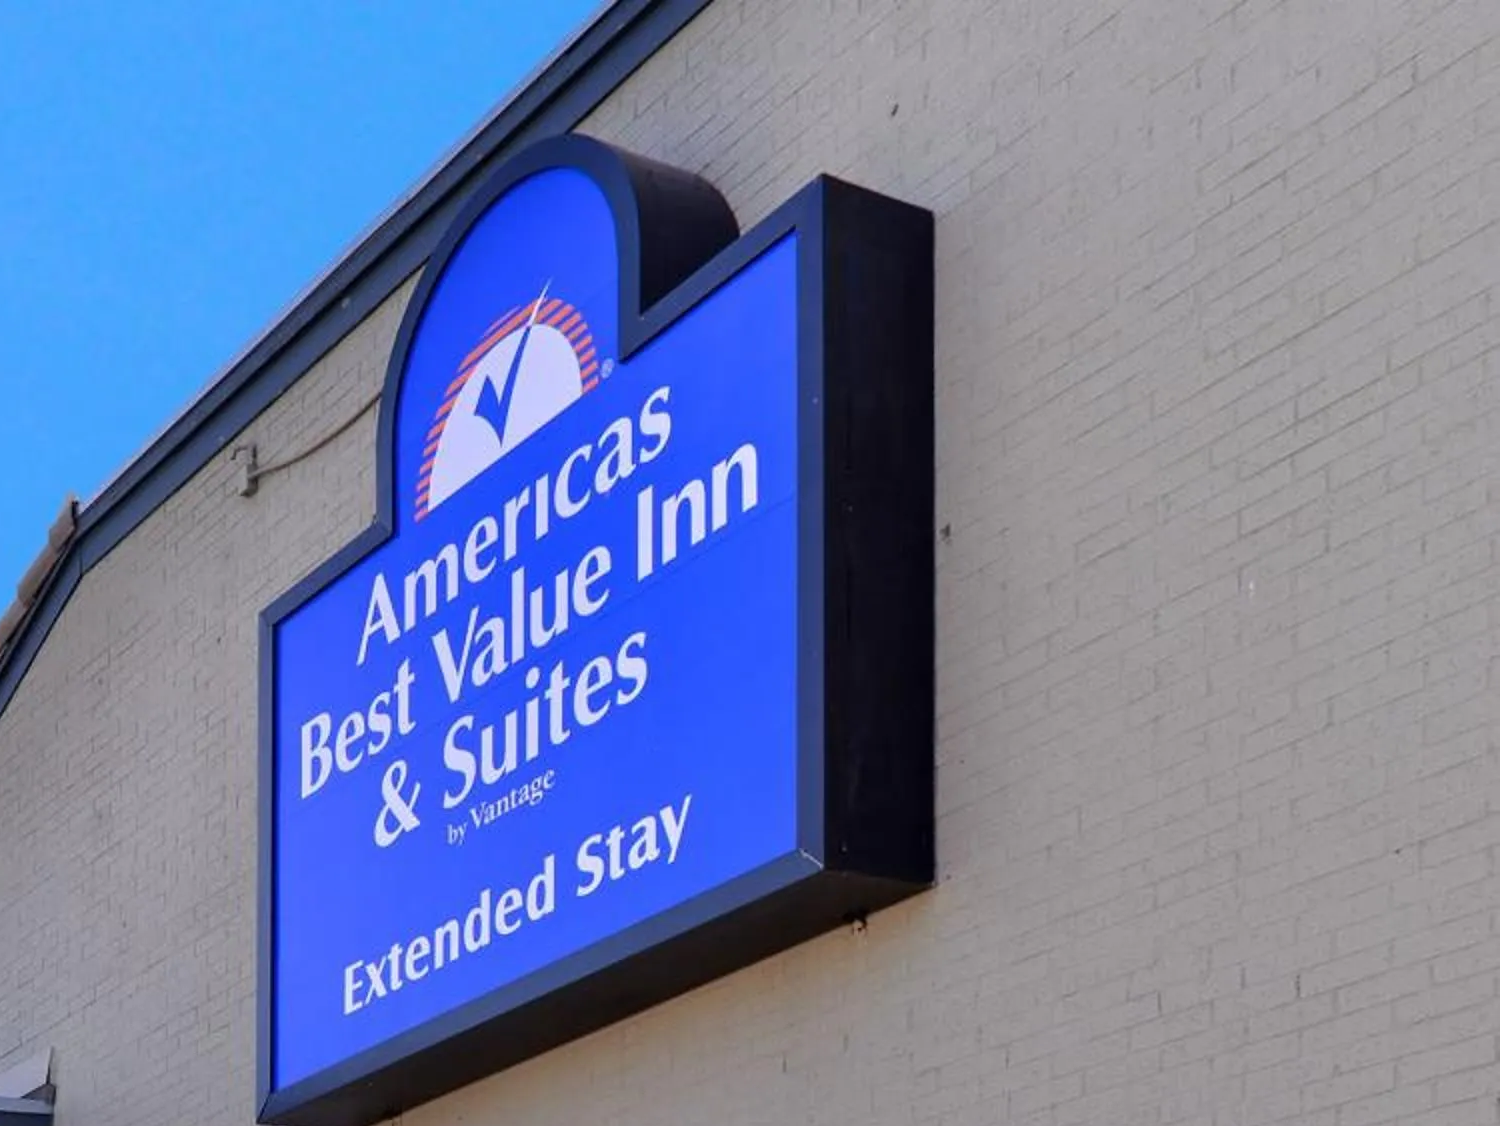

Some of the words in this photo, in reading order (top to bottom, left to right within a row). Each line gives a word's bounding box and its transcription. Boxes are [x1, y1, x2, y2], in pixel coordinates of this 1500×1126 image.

[301, 659, 416, 799] Best
[432, 546, 612, 706] Value
[637, 443, 758, 581] Inn
[357, 386, 671, 665] Americas
[374, 760, 421, 847] &
[443, 632, 647, 809] Suites
[447, 821, 468, 846] by
[470, 769, 556, 829] Vantage
[344, 854, 555, 1015] Extended
[576, 795, 691, 897] Stay
